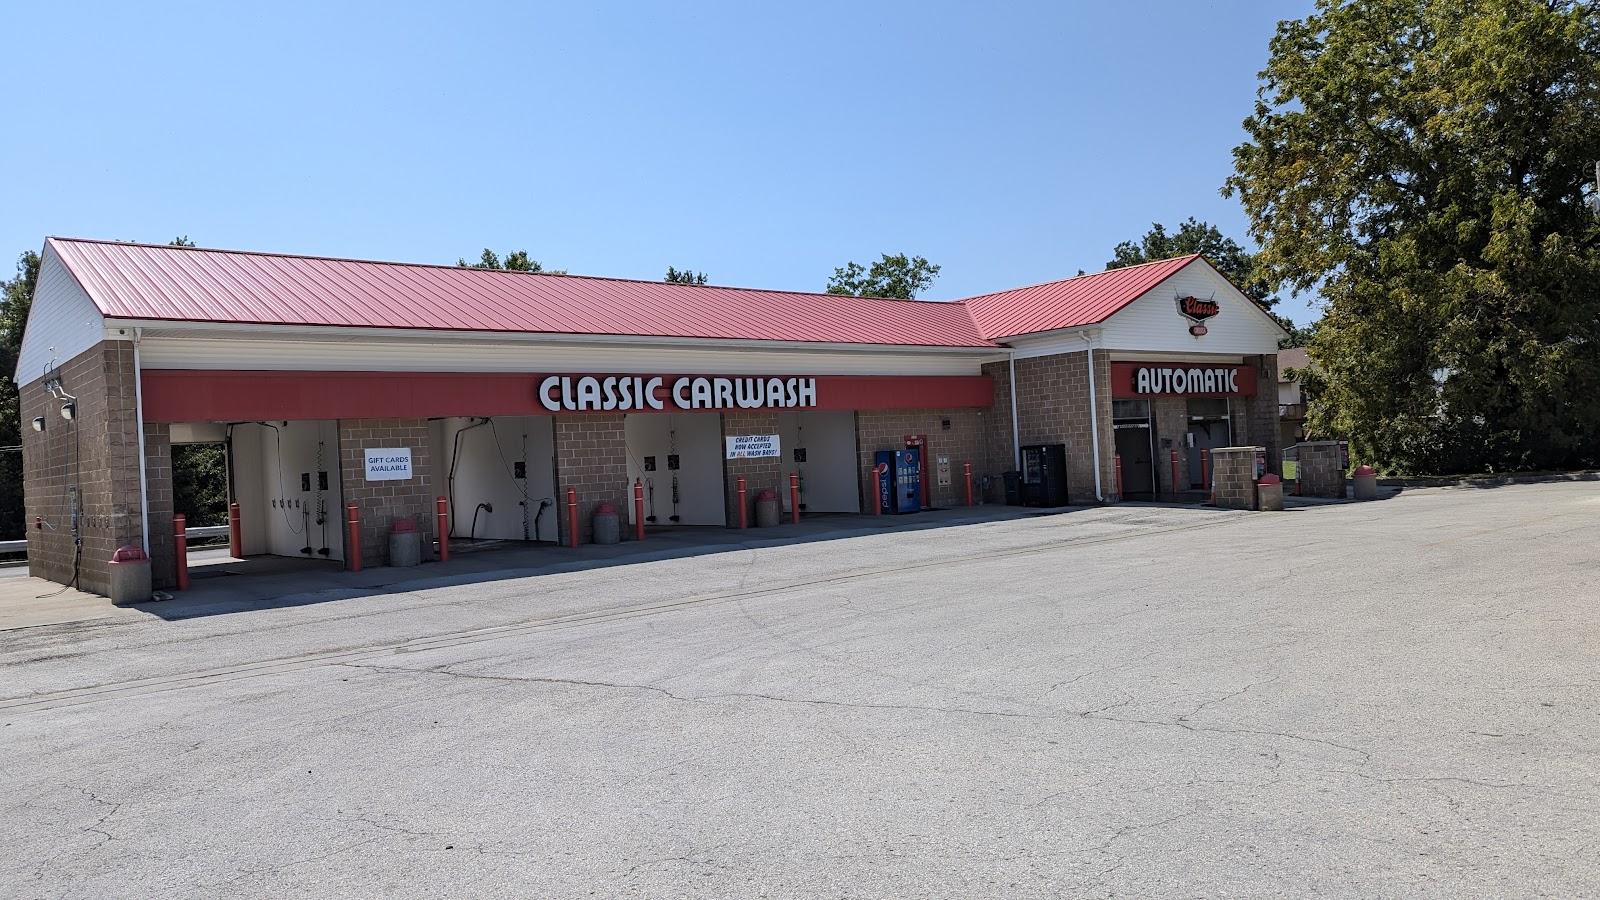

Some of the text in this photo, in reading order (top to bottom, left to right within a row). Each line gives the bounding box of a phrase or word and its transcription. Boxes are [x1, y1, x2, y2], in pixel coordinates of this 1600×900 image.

[539, 376, 817, 411] CLASSIC CARWASH
[1137, 367, 1239, 394] AUTOMATIC
[881, 479, 889, 508] pepsi
